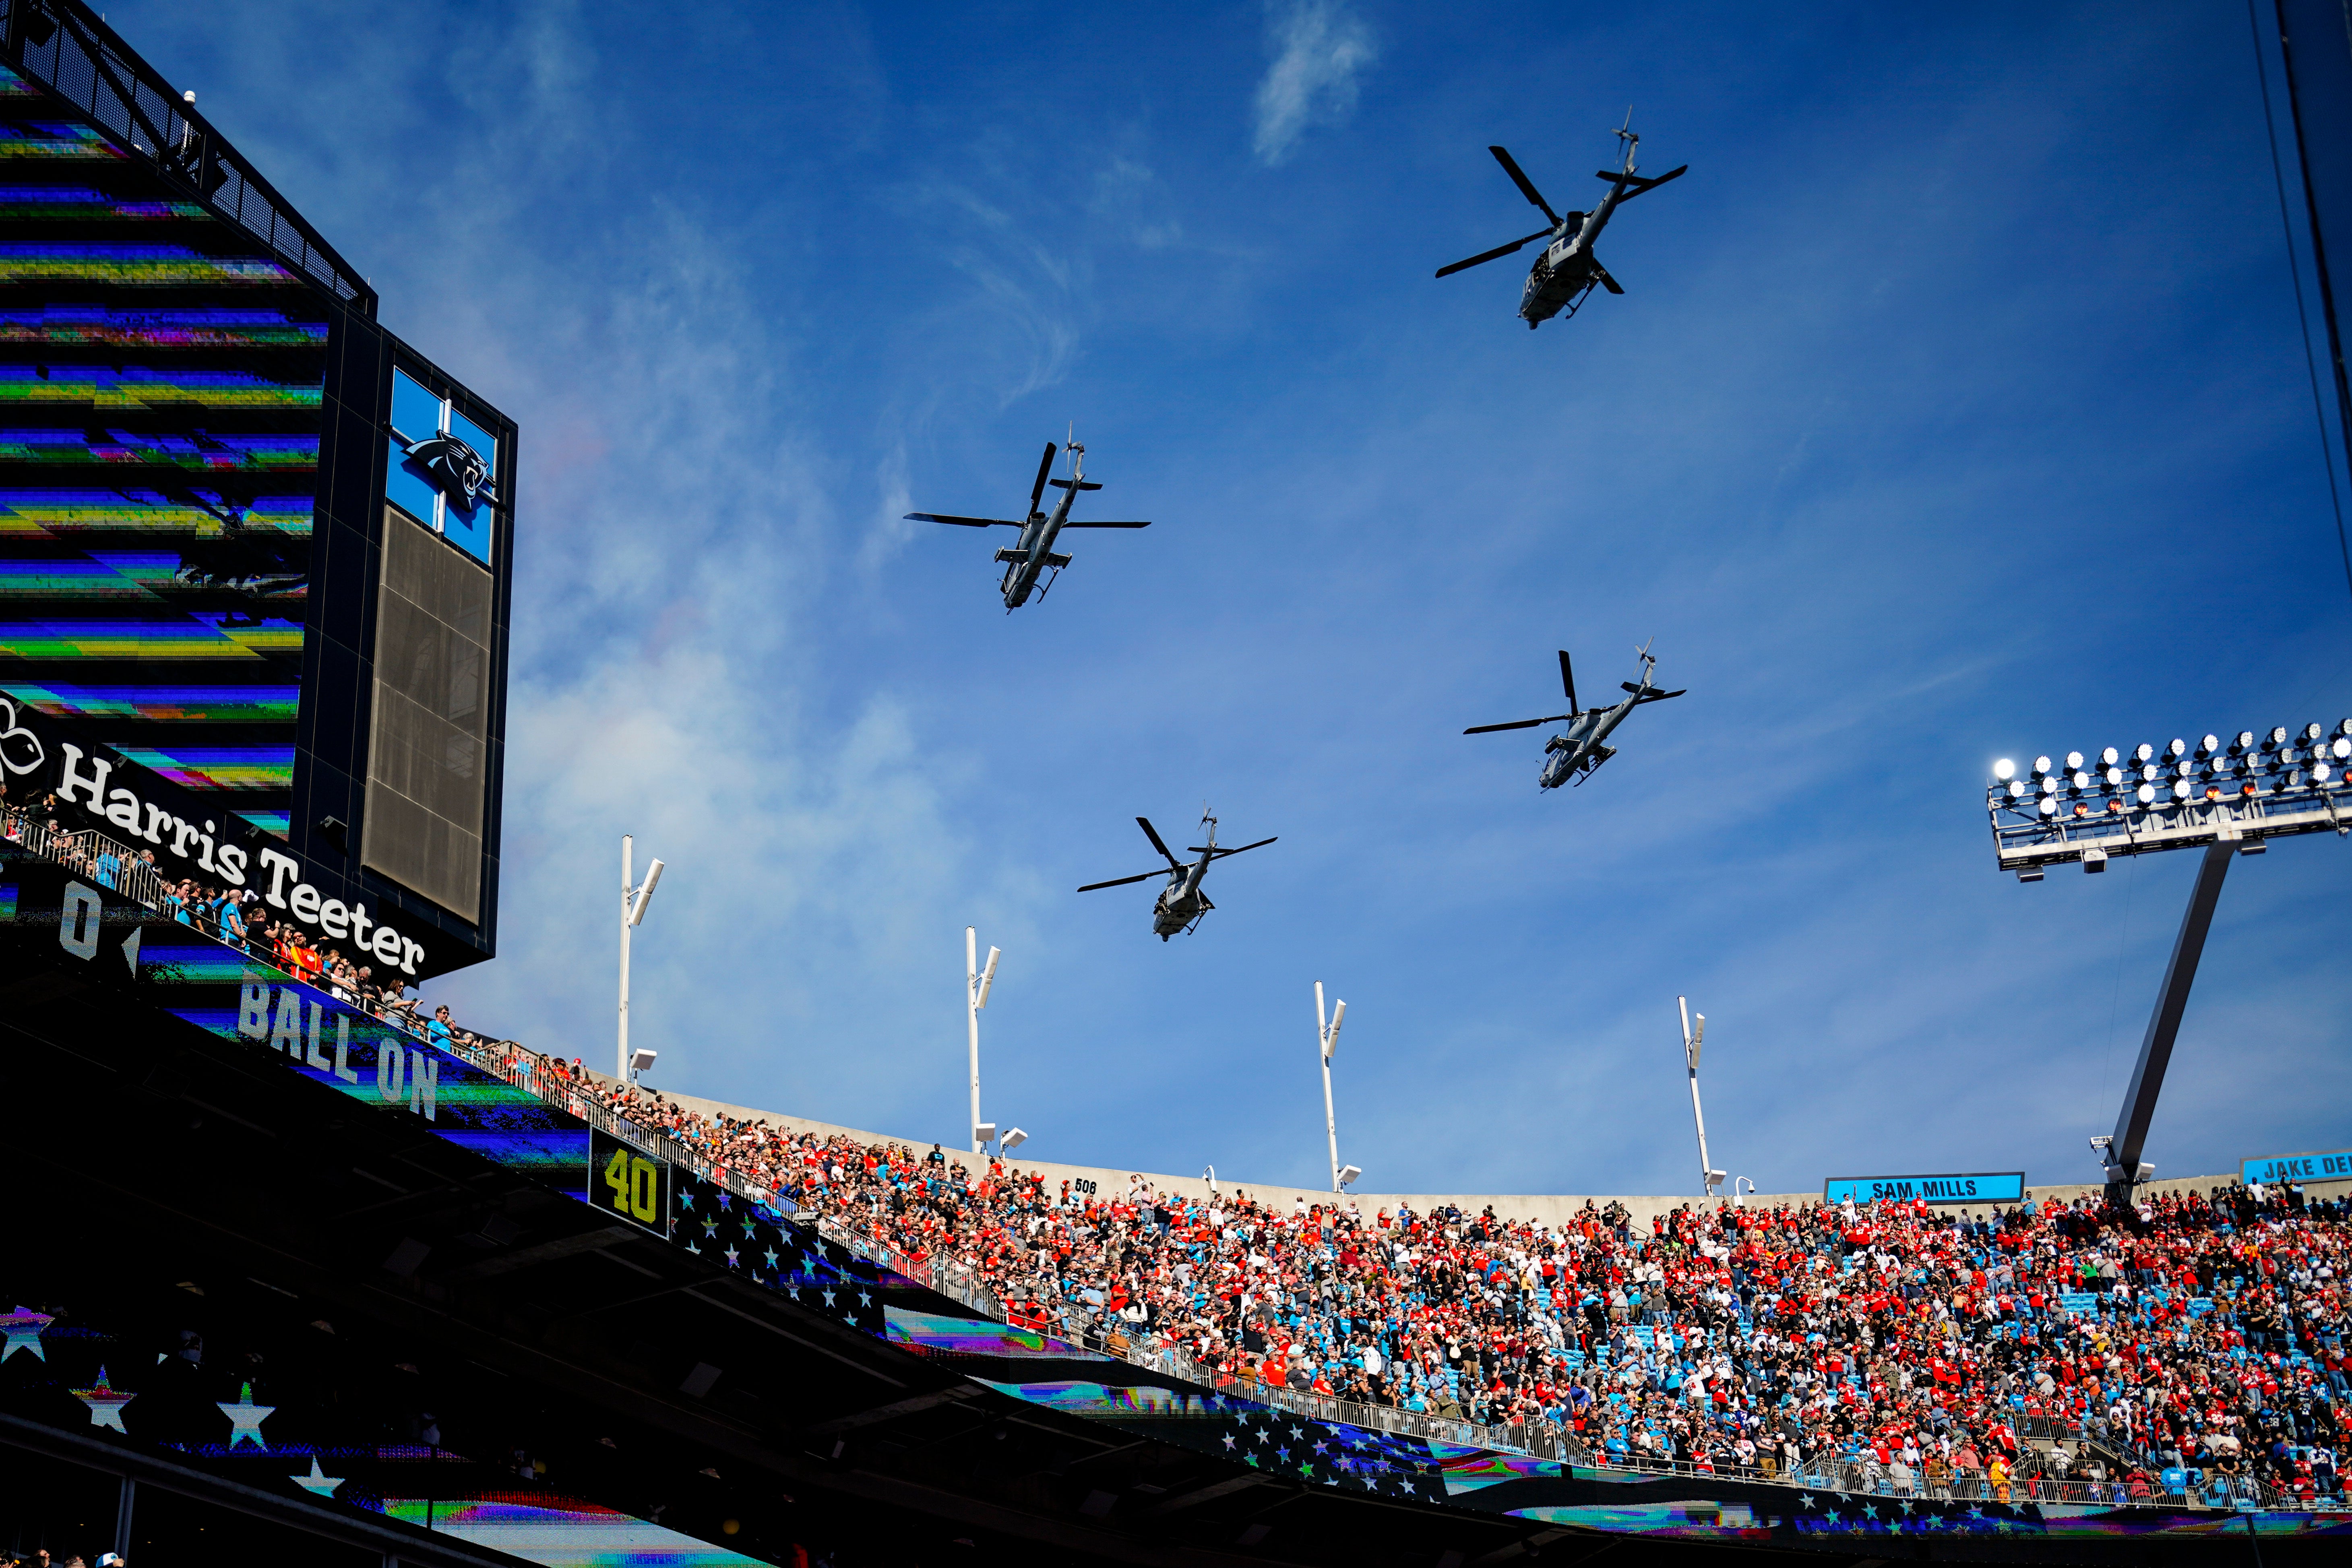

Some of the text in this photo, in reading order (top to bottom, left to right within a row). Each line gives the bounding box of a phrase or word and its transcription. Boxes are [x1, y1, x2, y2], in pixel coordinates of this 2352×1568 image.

[56, 743, 425, 975] Harris Teeter
[238, 969, 438, 1121] BALL ON
[2264, 1159, 2314, 1178] JAKE
[605, 1149, 657, 1223] 40
[1075, 1178, 1097, 1195] 506
[1873, 1180, 1976, 1198] SAM MILLS
[1677, 1272, 1686, 1280] 15
[1556, 1292, 1565, 1300] 87
[2238, 1351, 2246, 1359] 17
[2271, 1354, 2280, 1364] 15
[2211, 1413, 2224, 1424] 23
[2004, 1429, 2013, 1438] 87
[2339, 1434, 2350, 1443] 15
